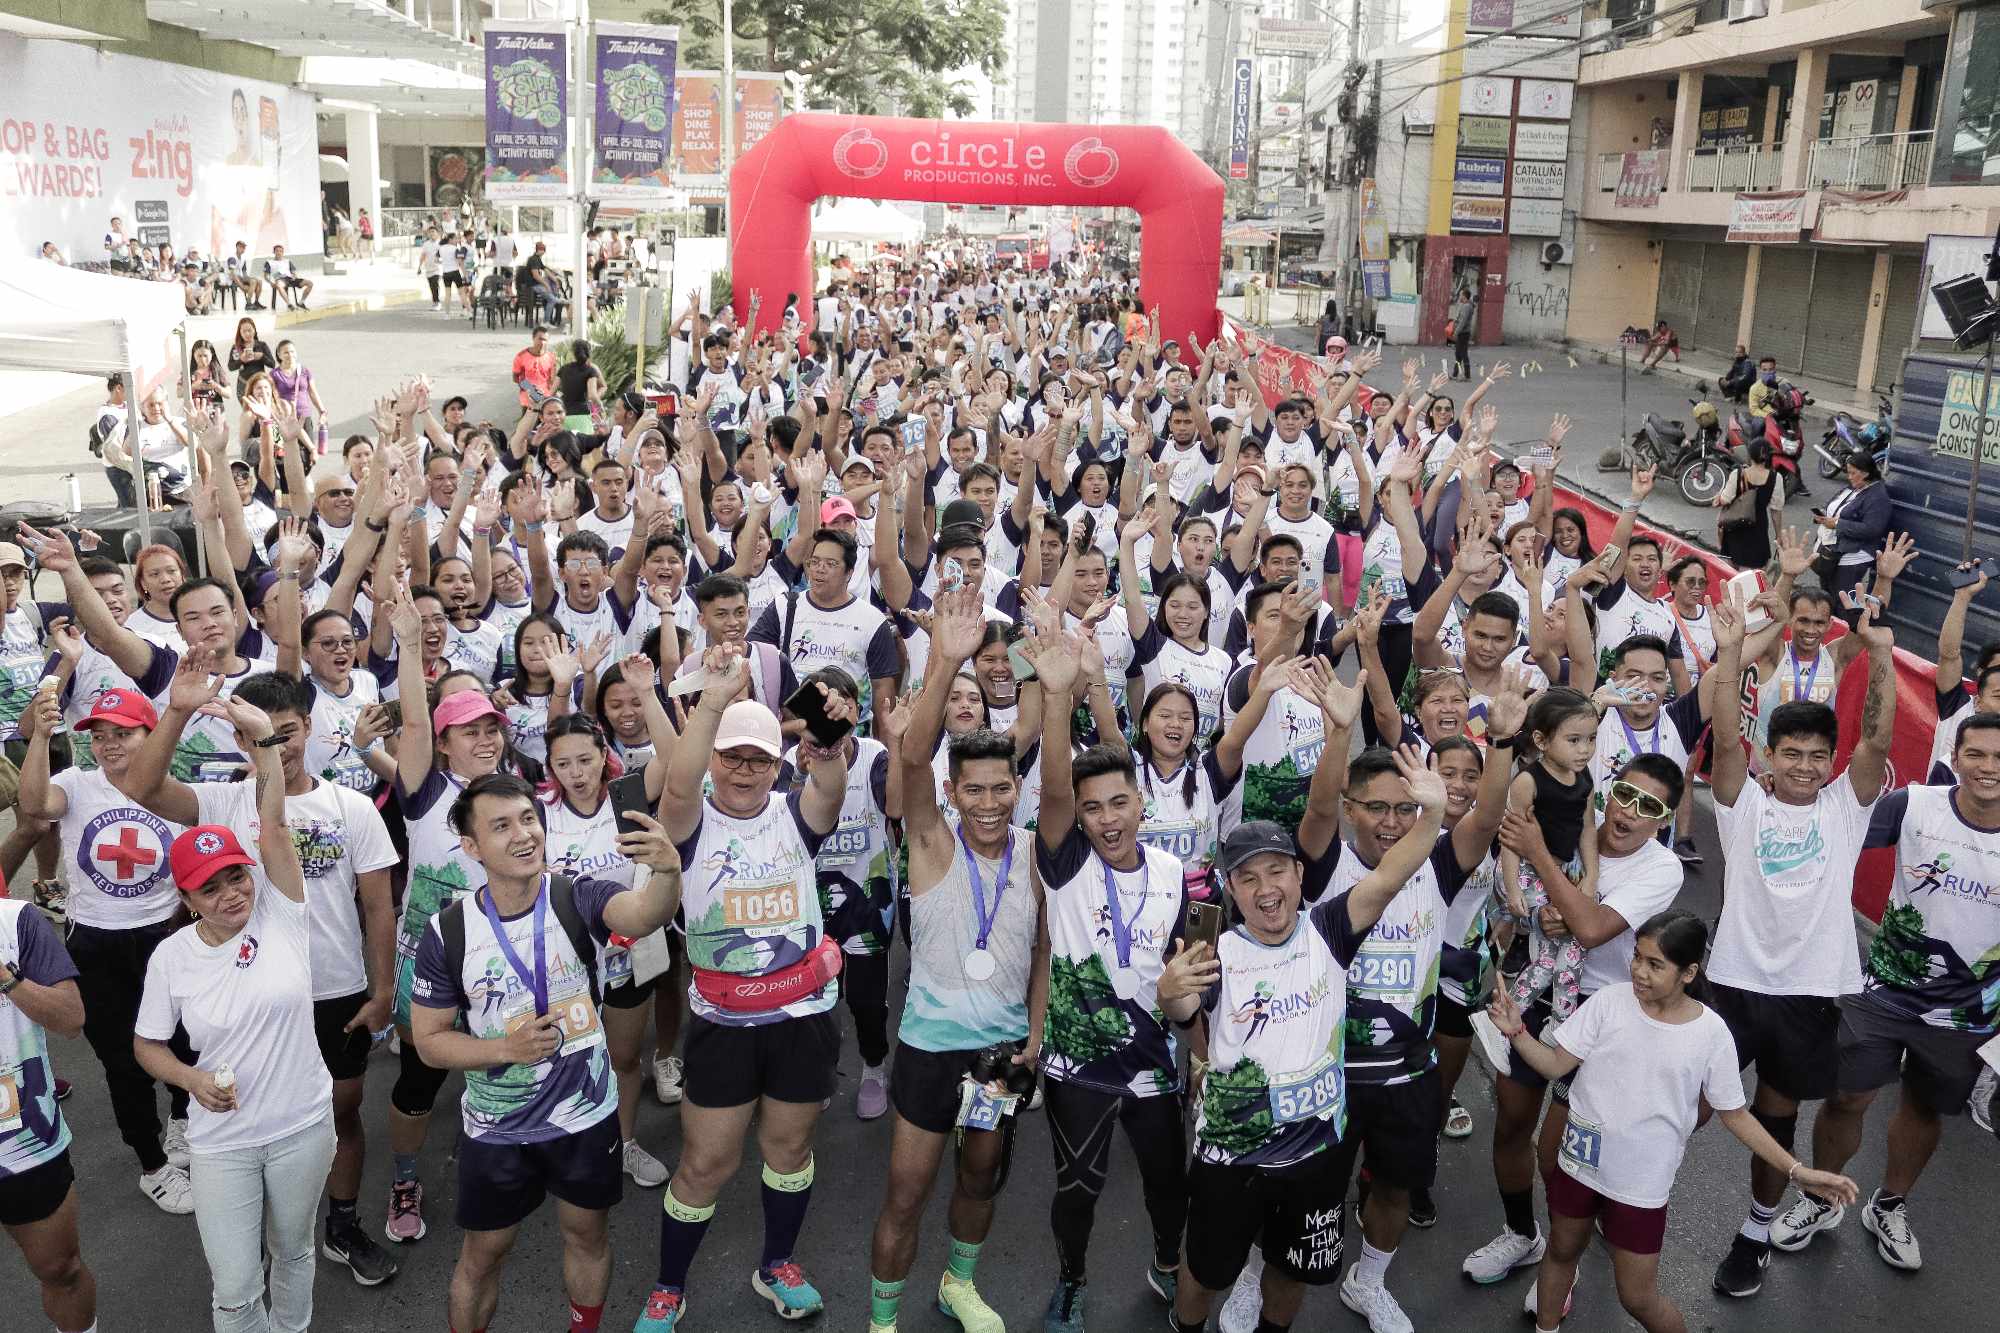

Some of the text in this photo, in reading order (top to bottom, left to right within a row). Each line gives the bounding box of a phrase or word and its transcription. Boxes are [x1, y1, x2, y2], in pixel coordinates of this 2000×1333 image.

[683, 109, 712, 119] SHOP
[745, 111, 773, 121] SHOP
[685, 120, 711, 129] DINE
[44, 122, 60, 157] &
[66, 126, 110, 160] BAG
[685, 131, 711, 139] PLAY
[498, 148, 527, 159] ACTIVITY
[682, 141, 715, 150] RELAX
[910, 132, 1048, 170] circle
[1458, 161, 1501, 173] Rubrics
[1516, 164, 1563, 177] CATALUÑA
[903, 169, 1057, 188] PRODUCTIONS, INC.
[93, 809, 166, 836] PHILIPPINE
[91, 871, 161, 897] RED CROSS
[730, 889, 794, 921] 1056
[1348, 957, 1412, 986] 5290
[769, 973, 802, 993] point
[1277, 1070, 1337, 1119] 5289
[1300, 1224, 1340, 1249] THAN
[1286, 1247, 1303, 1270] AN
